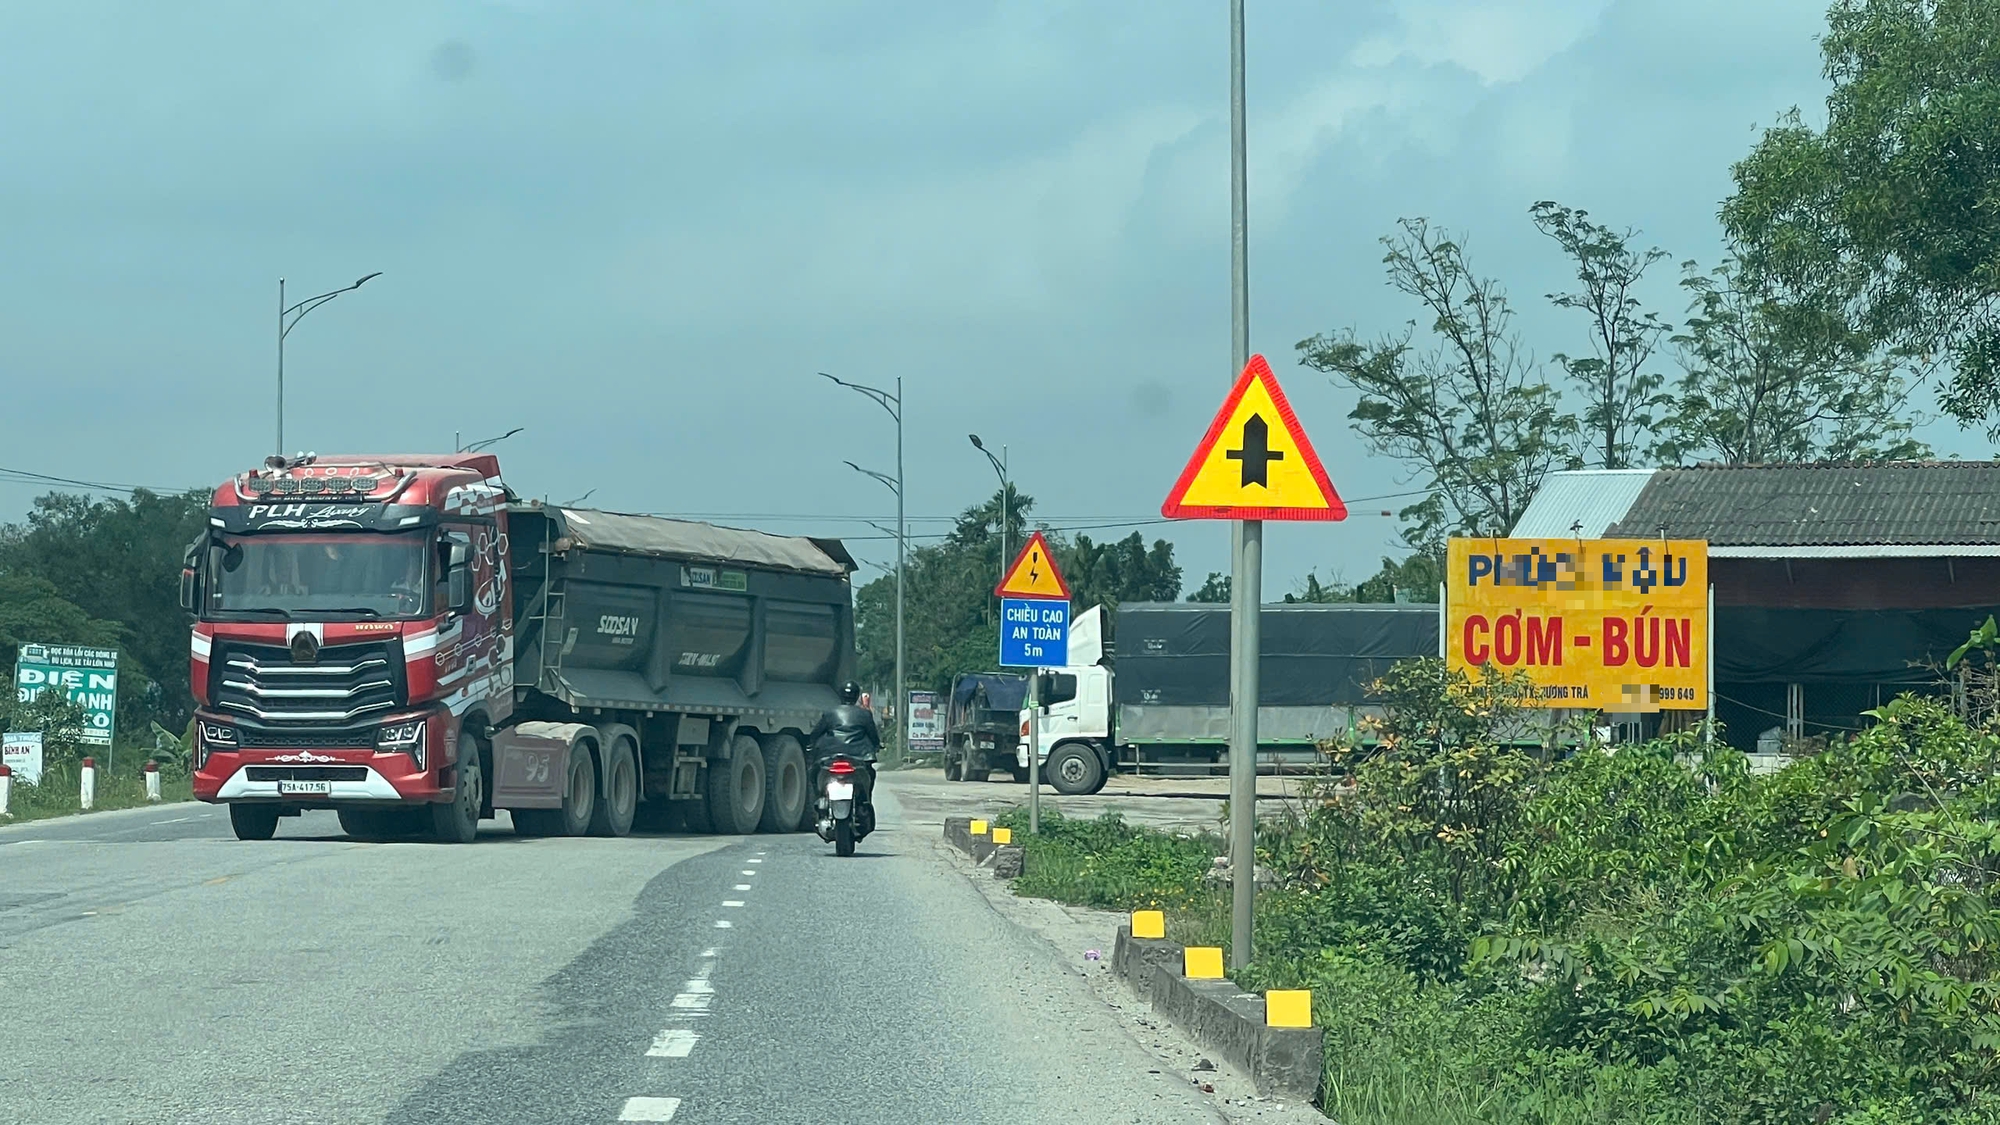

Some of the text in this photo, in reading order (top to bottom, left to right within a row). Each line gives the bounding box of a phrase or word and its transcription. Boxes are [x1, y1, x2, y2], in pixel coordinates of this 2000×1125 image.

[248, 503, 370, 519] PLH Luxury
[1006, 602, 1063, 623] CHIỀU CAO
[597, 615, 639, 636] SOOSAN
[1012, 624, 1061, 640] AN TOÀN
[1463, 608, 1563, 667] CƠM
[1602, 604, 1691, 668] BÚN
[19, 668, 115, 690] ĐIỆN
[526, 753, 550, 783] 95
